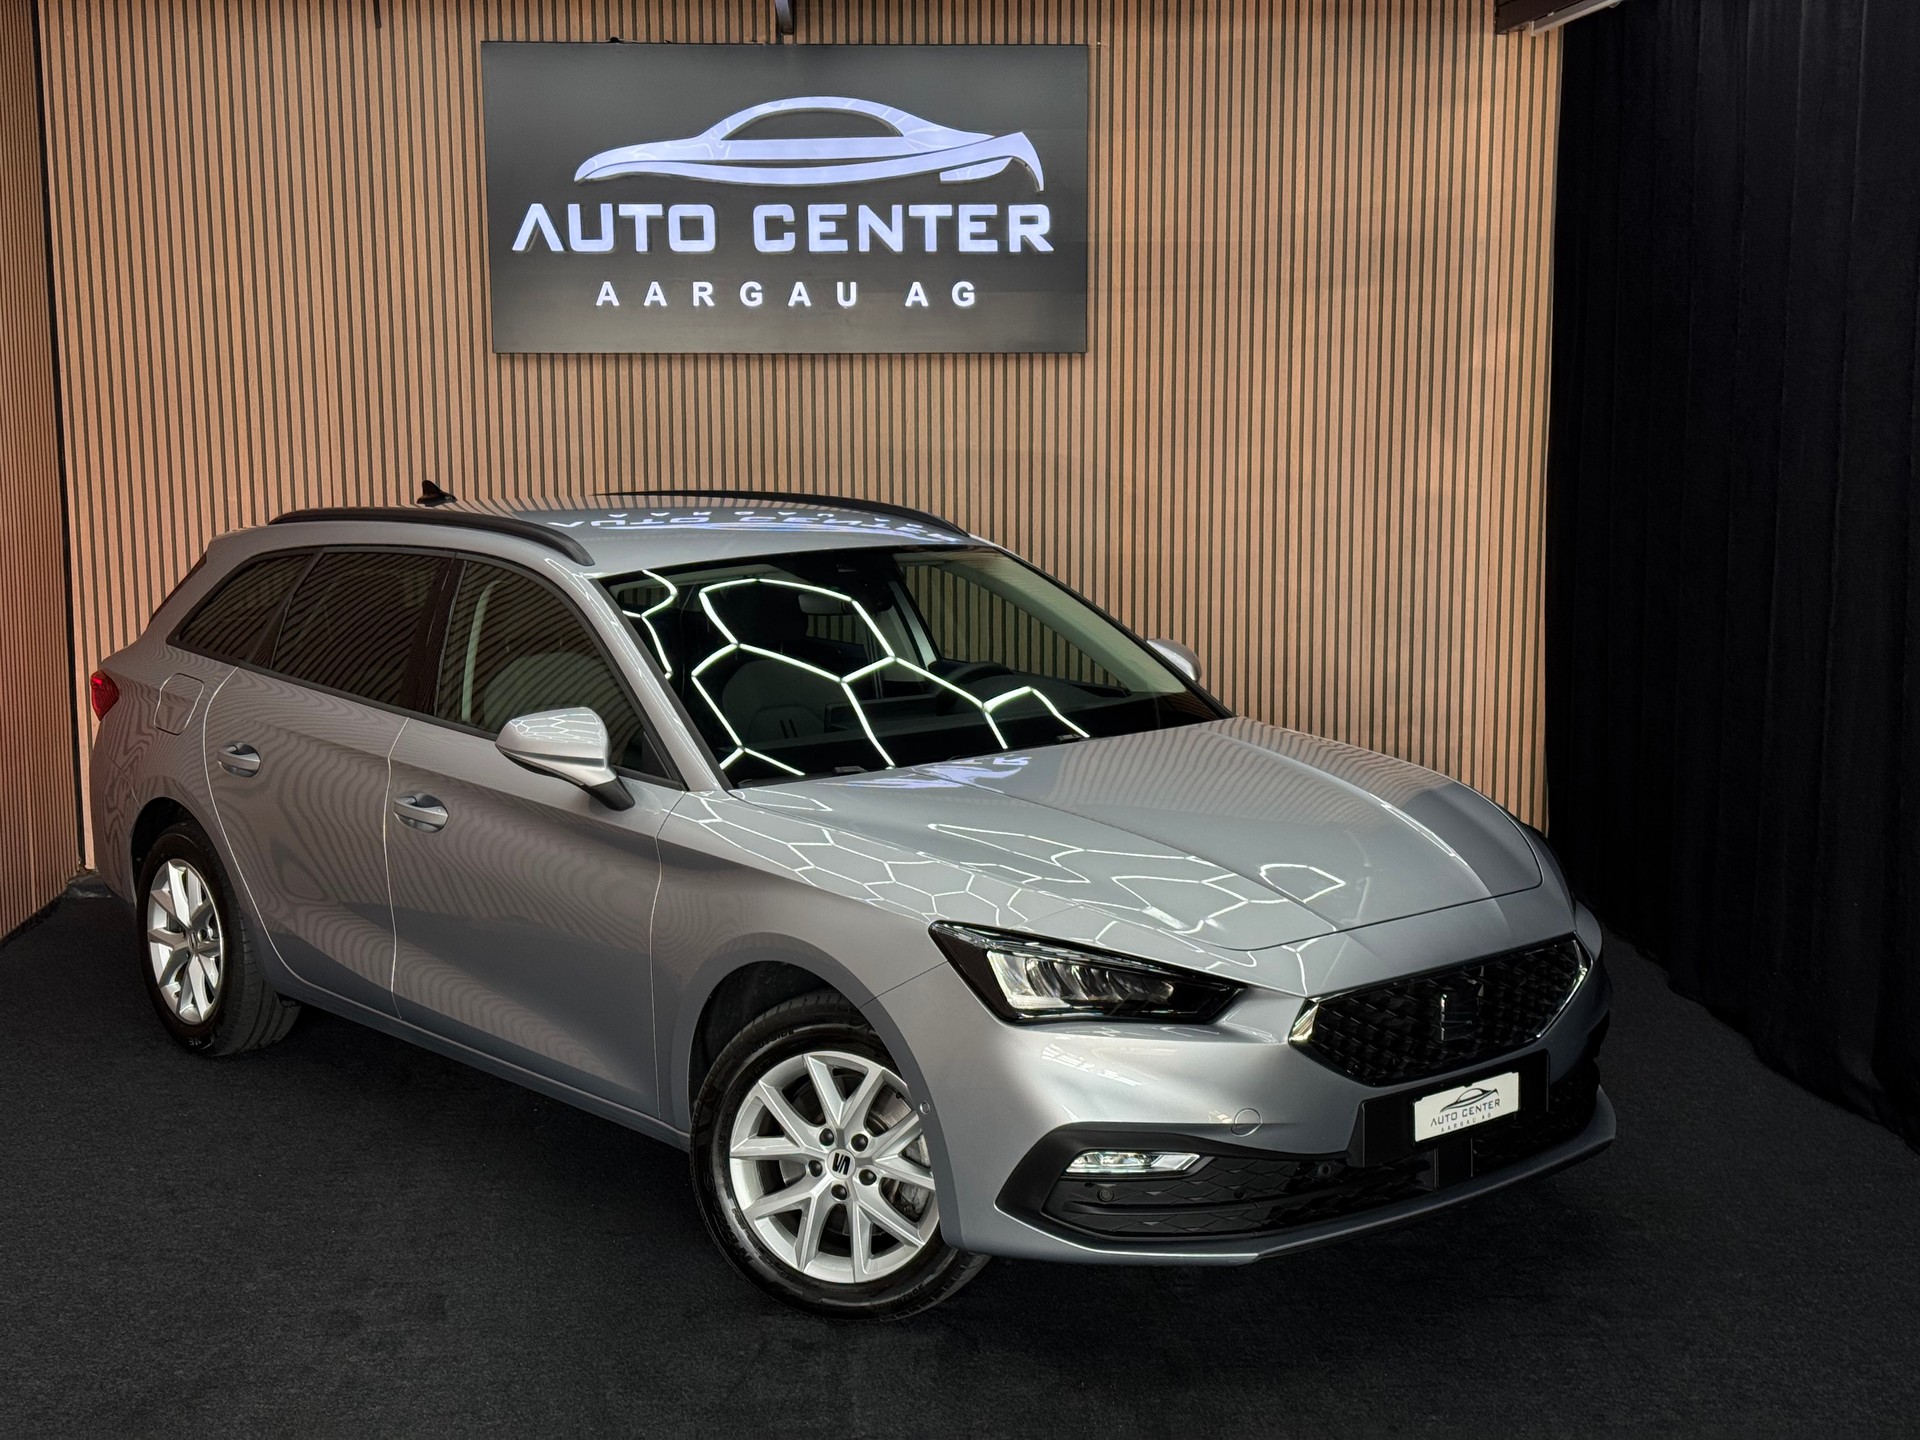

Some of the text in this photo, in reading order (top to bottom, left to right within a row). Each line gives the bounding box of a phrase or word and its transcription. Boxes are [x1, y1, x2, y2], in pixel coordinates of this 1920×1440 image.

[512, 203, 1055, 253] AUTO CENTER
[595, 281, 976, 308] AARGAU AG
[1430, 1098, 1500, 1126] AUTO CENTER
